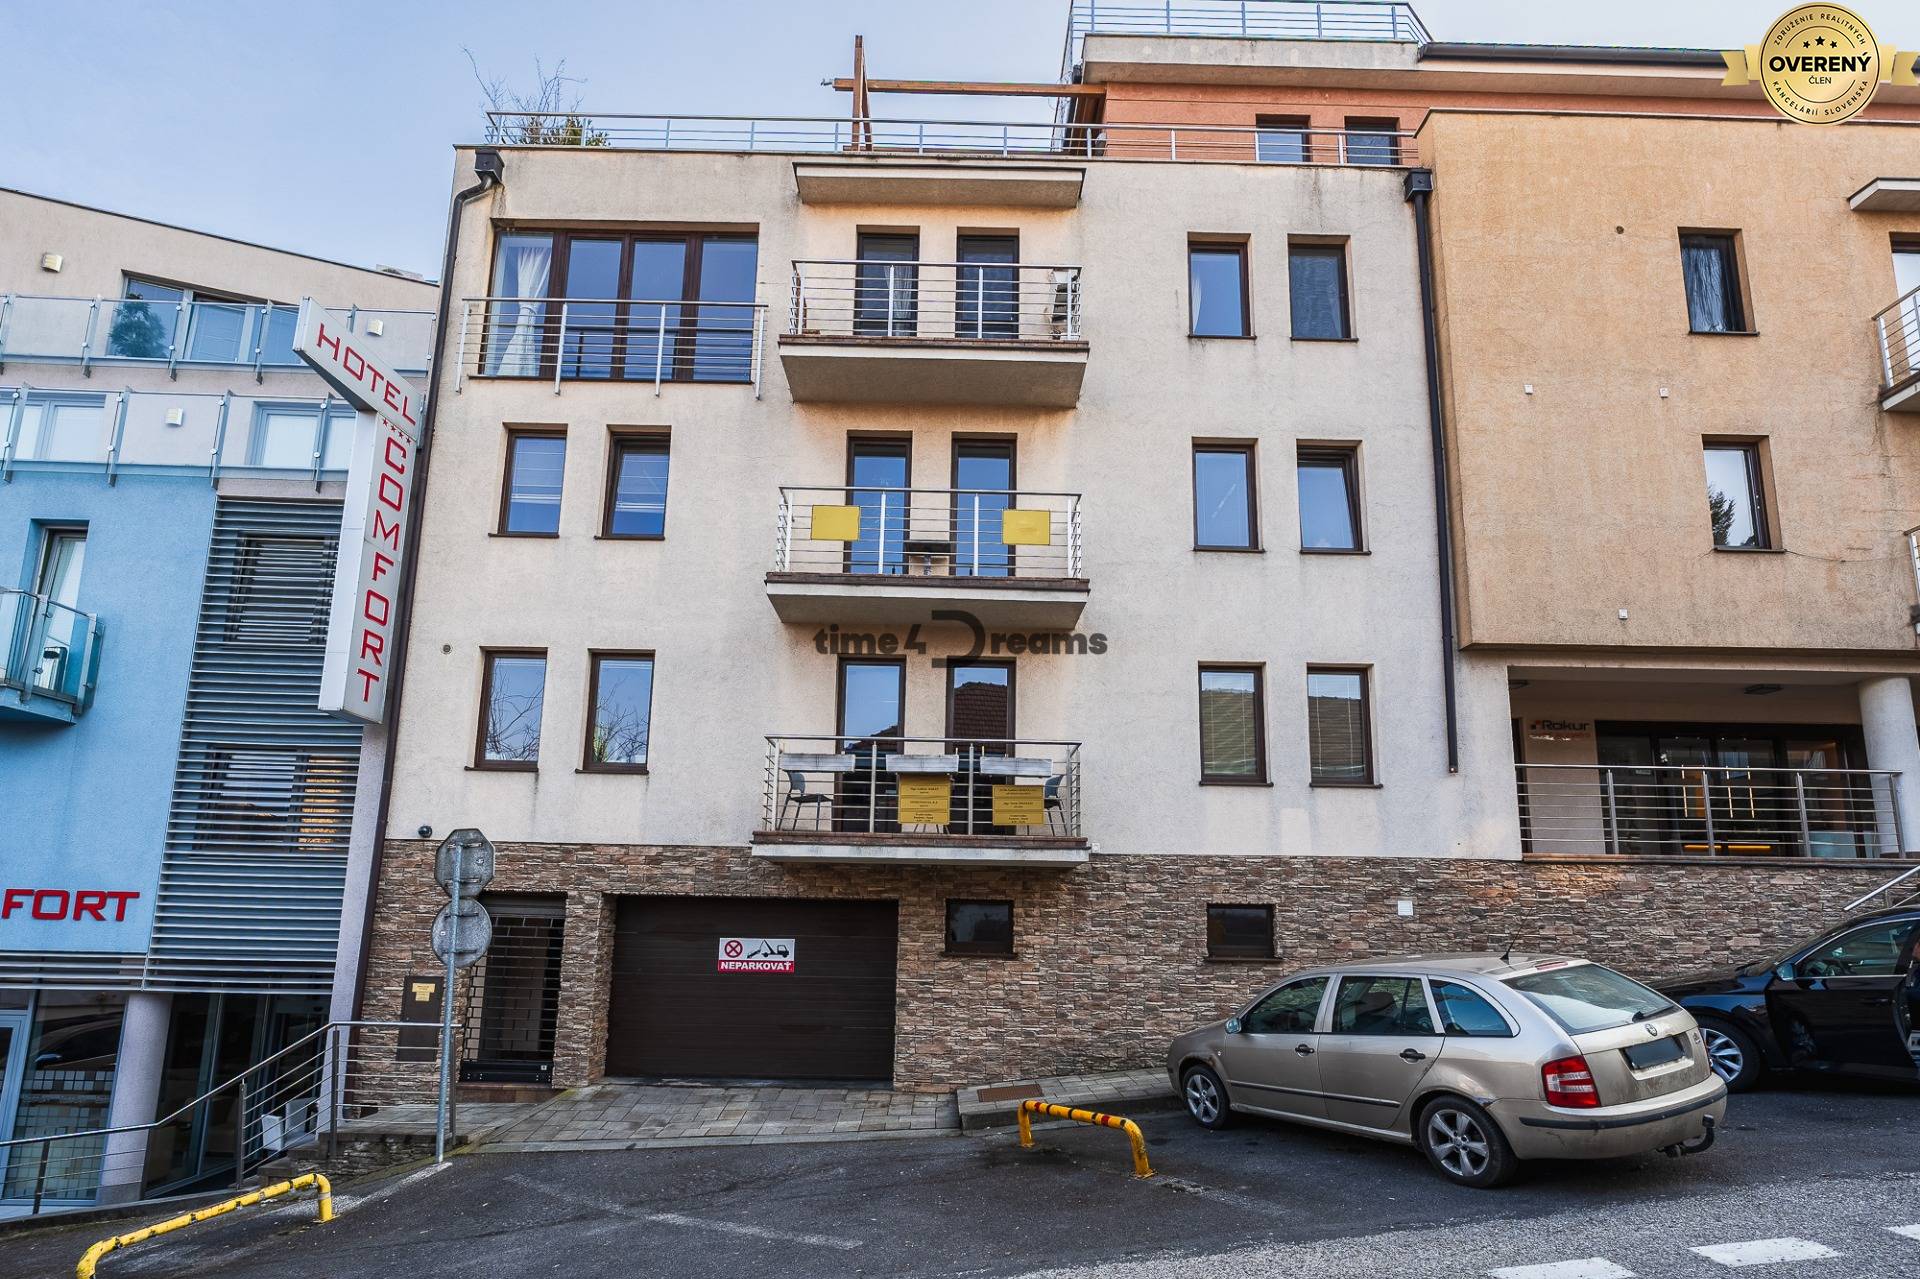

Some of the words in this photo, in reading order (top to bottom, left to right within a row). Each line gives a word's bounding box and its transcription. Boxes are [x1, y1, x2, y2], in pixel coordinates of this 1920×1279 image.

[316, 322, 416, 426] HOTEL
[357, 436, 407, 703] COMFORT
[1, 888, 140, 921] FORT
[720, 961, 792, 971] NEPARKOVAŤ
